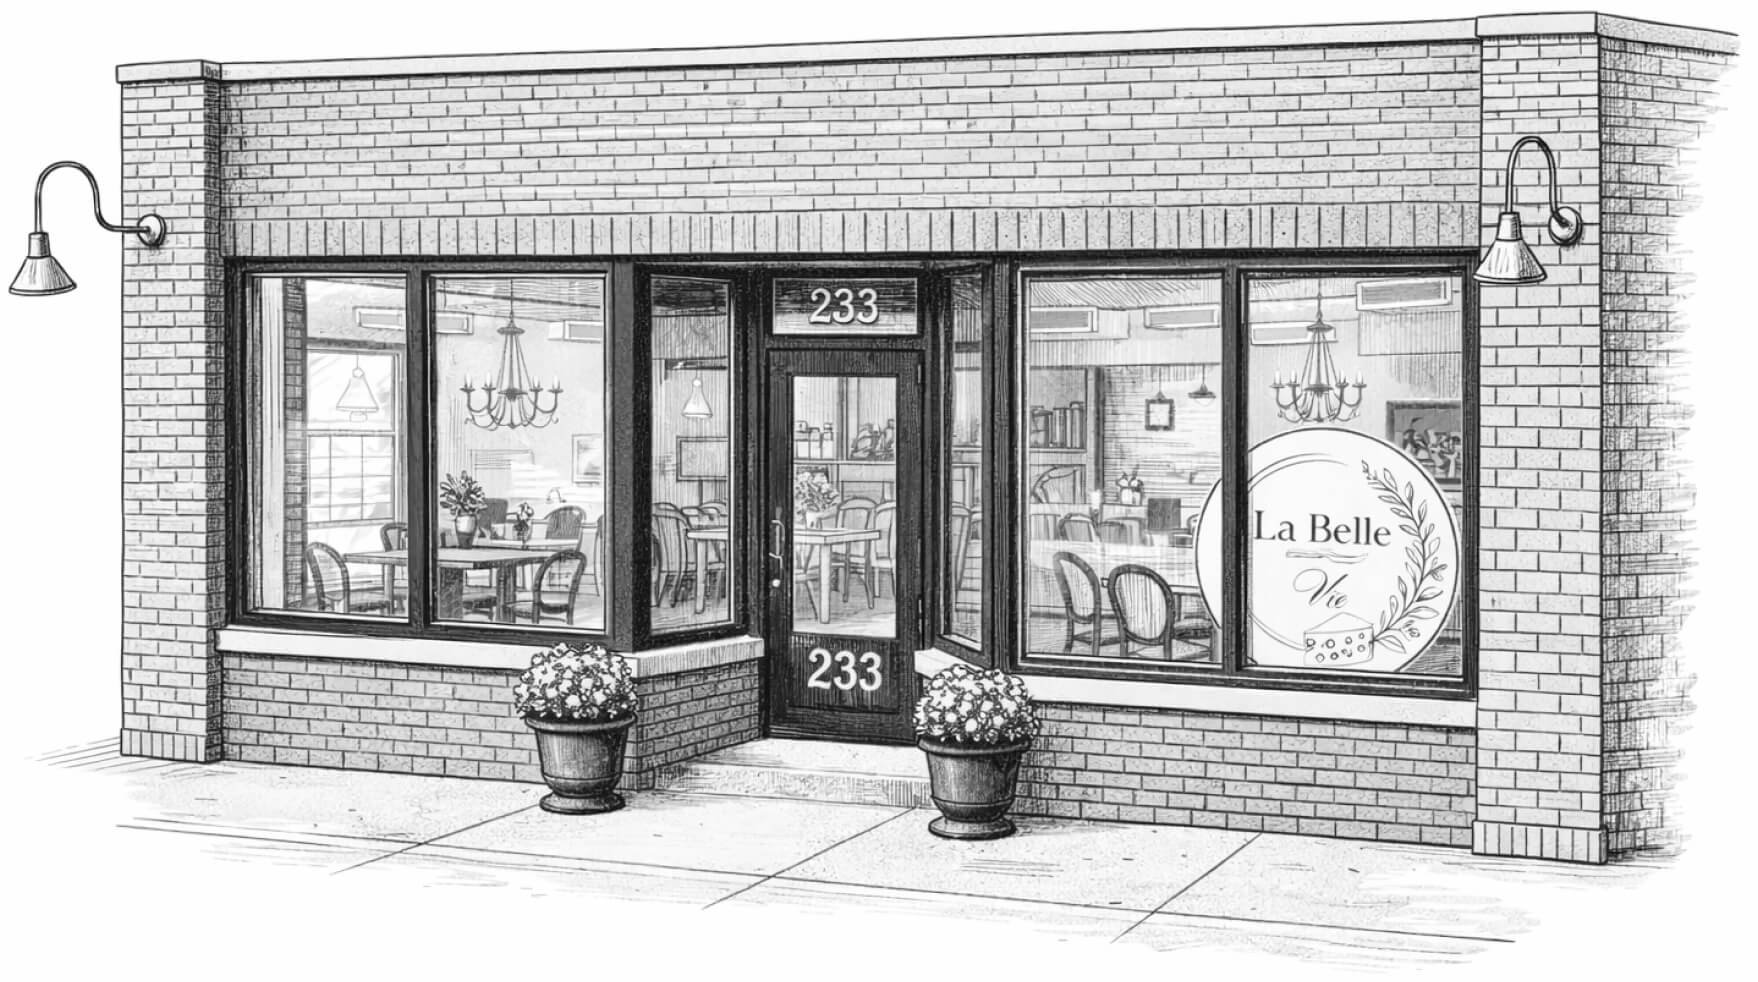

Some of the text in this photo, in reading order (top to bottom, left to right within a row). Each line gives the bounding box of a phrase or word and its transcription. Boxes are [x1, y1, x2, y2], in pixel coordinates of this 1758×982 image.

[810, 288, 878, 323] 233
[1254, 510, 1391, 547] La Belle
[1293, 568, 1349, 608] Vie
[807, 648, 882, 691] 233
